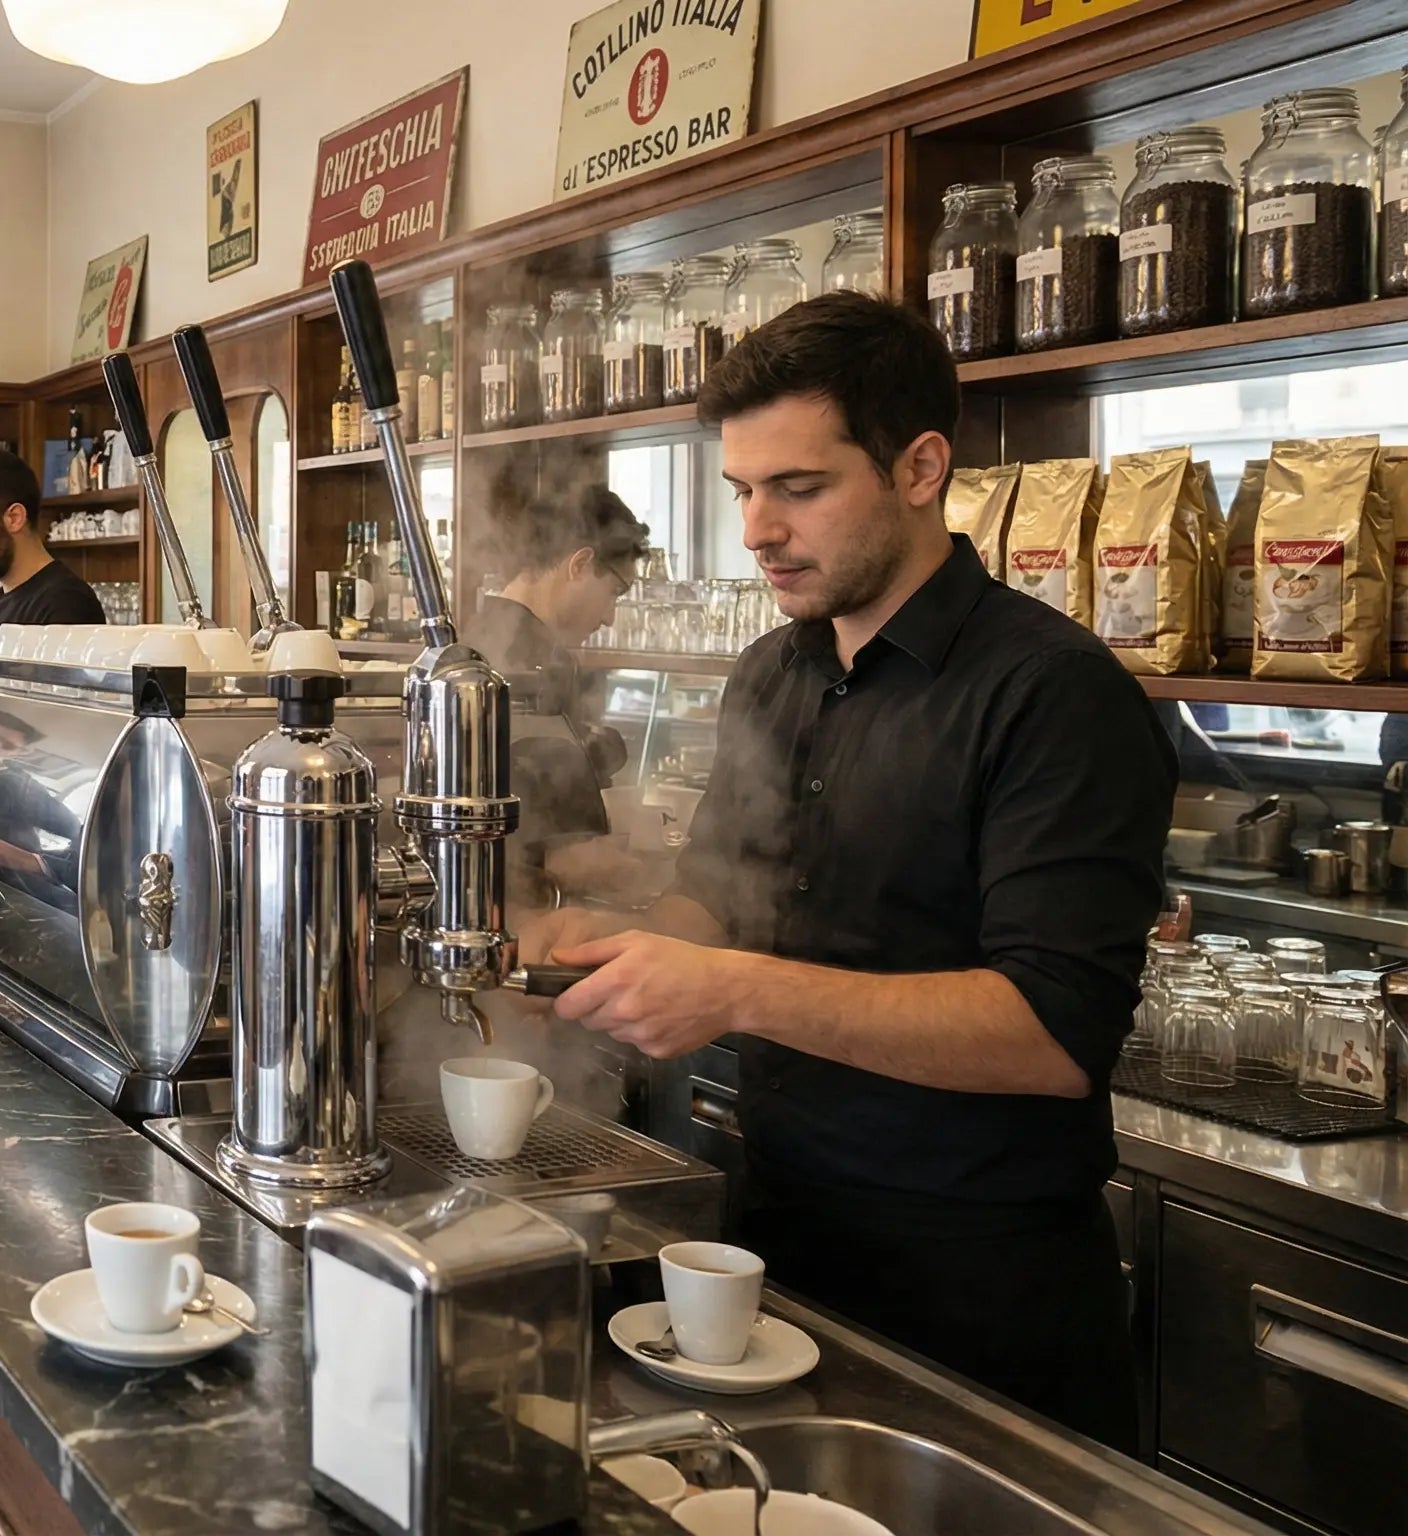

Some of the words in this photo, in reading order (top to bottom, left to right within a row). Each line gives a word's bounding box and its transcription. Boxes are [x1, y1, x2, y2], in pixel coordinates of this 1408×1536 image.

[572, 0, 665, 99] COTLLINO
[687, 106, 731, 149] BAR
[384, 199, 434, 244] ITALIA
